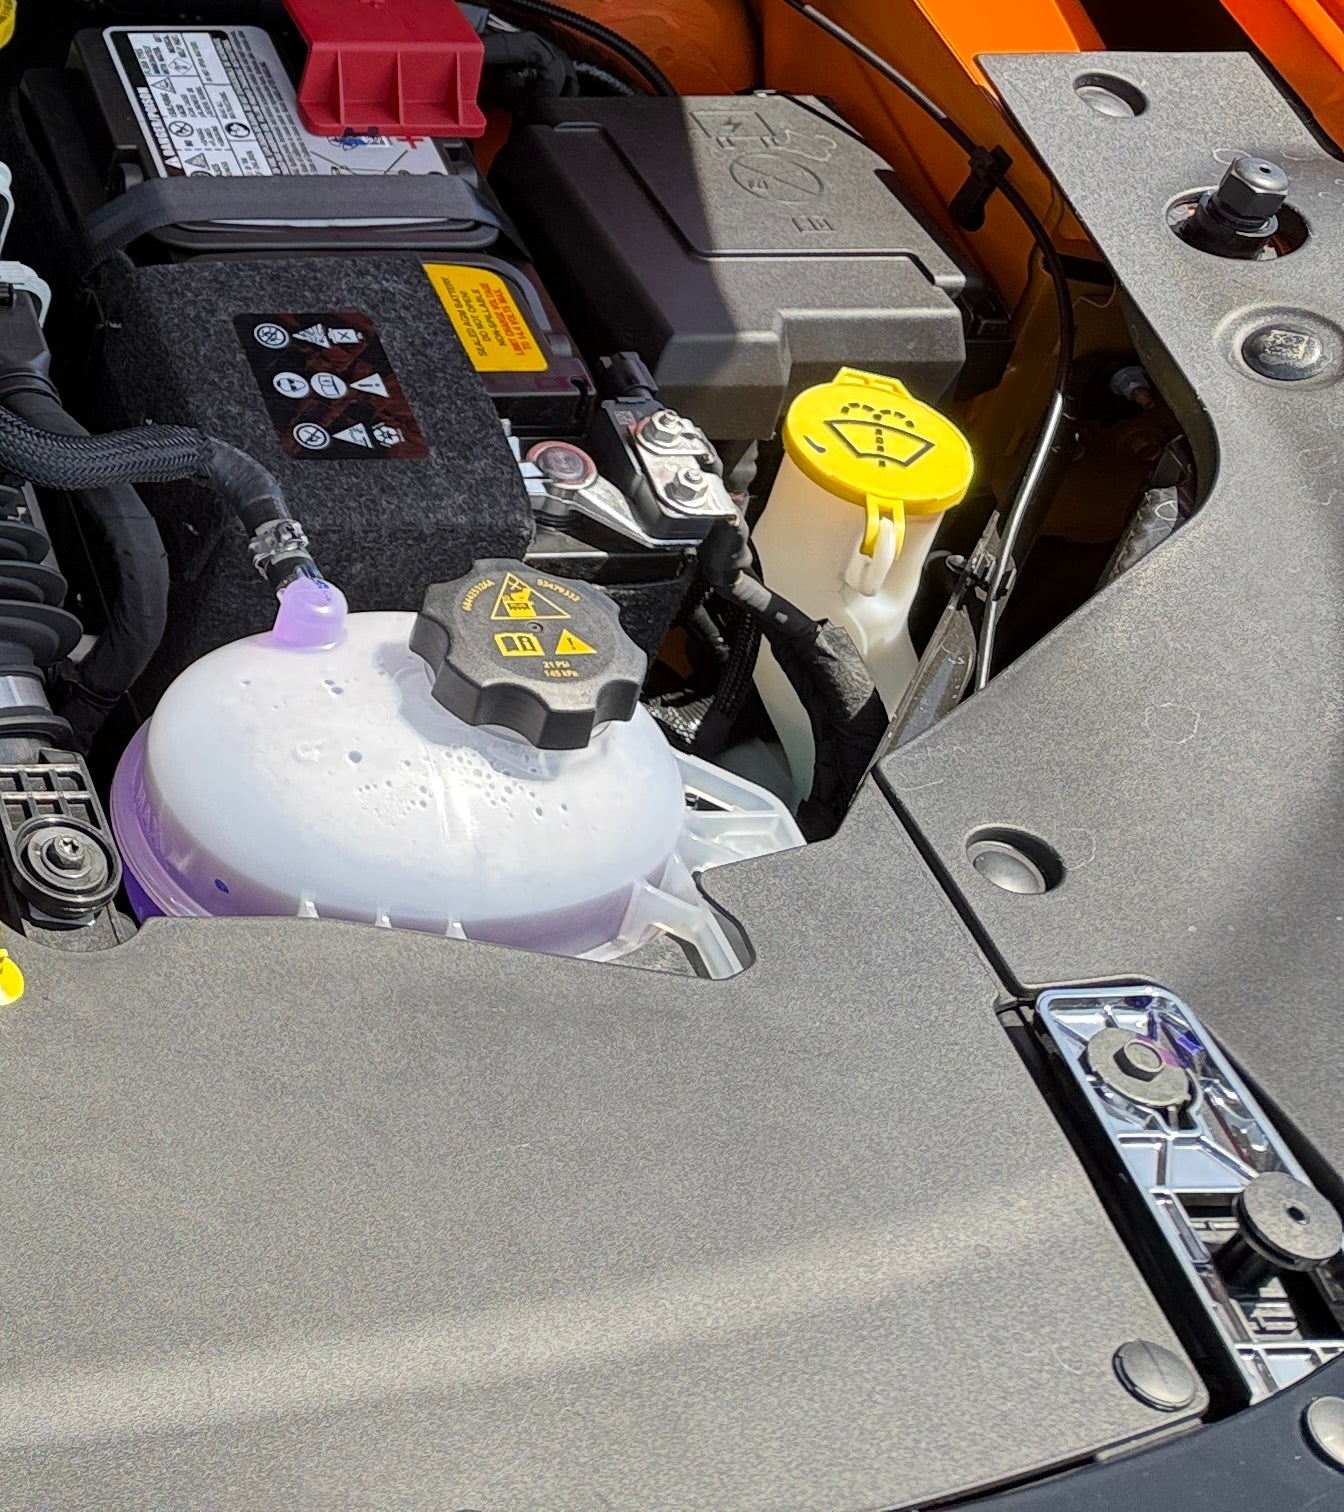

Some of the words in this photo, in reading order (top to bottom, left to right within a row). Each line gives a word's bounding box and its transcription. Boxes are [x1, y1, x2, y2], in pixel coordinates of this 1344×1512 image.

[441, 277, 463, 308] BATTERY
[469, 314, 485, 329] NOT
[466, 328, 488, 356] SEALED
